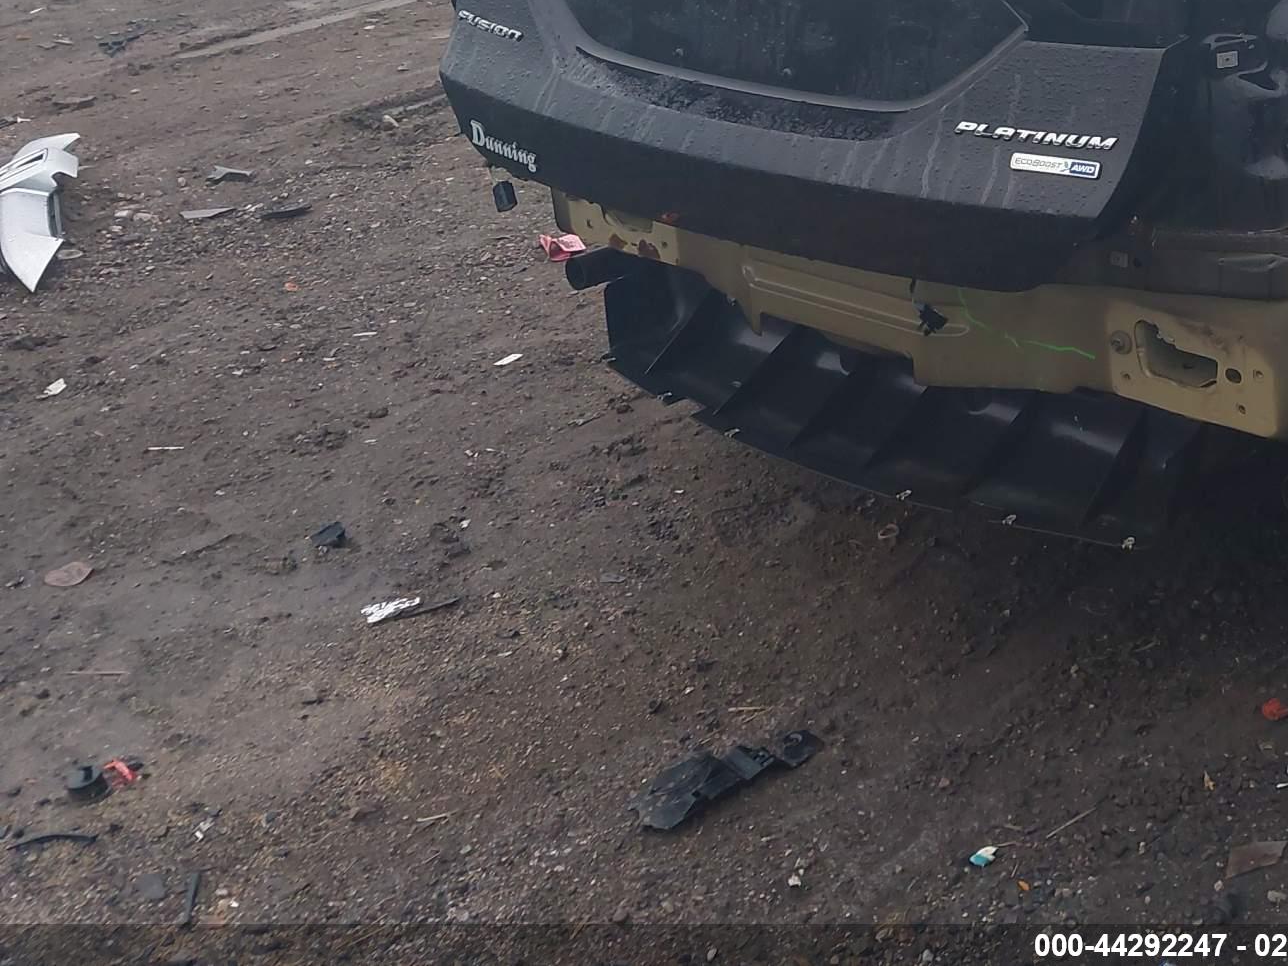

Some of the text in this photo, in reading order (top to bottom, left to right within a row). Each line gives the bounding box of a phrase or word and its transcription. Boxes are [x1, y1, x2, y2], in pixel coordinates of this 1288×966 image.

[458, 10, 523, 42] FUSION
[470, 119, 537, 172] Dunning
[954, 121, 1118, 150] PLATINUM
[1071, 164, 1096, 174] AWD
